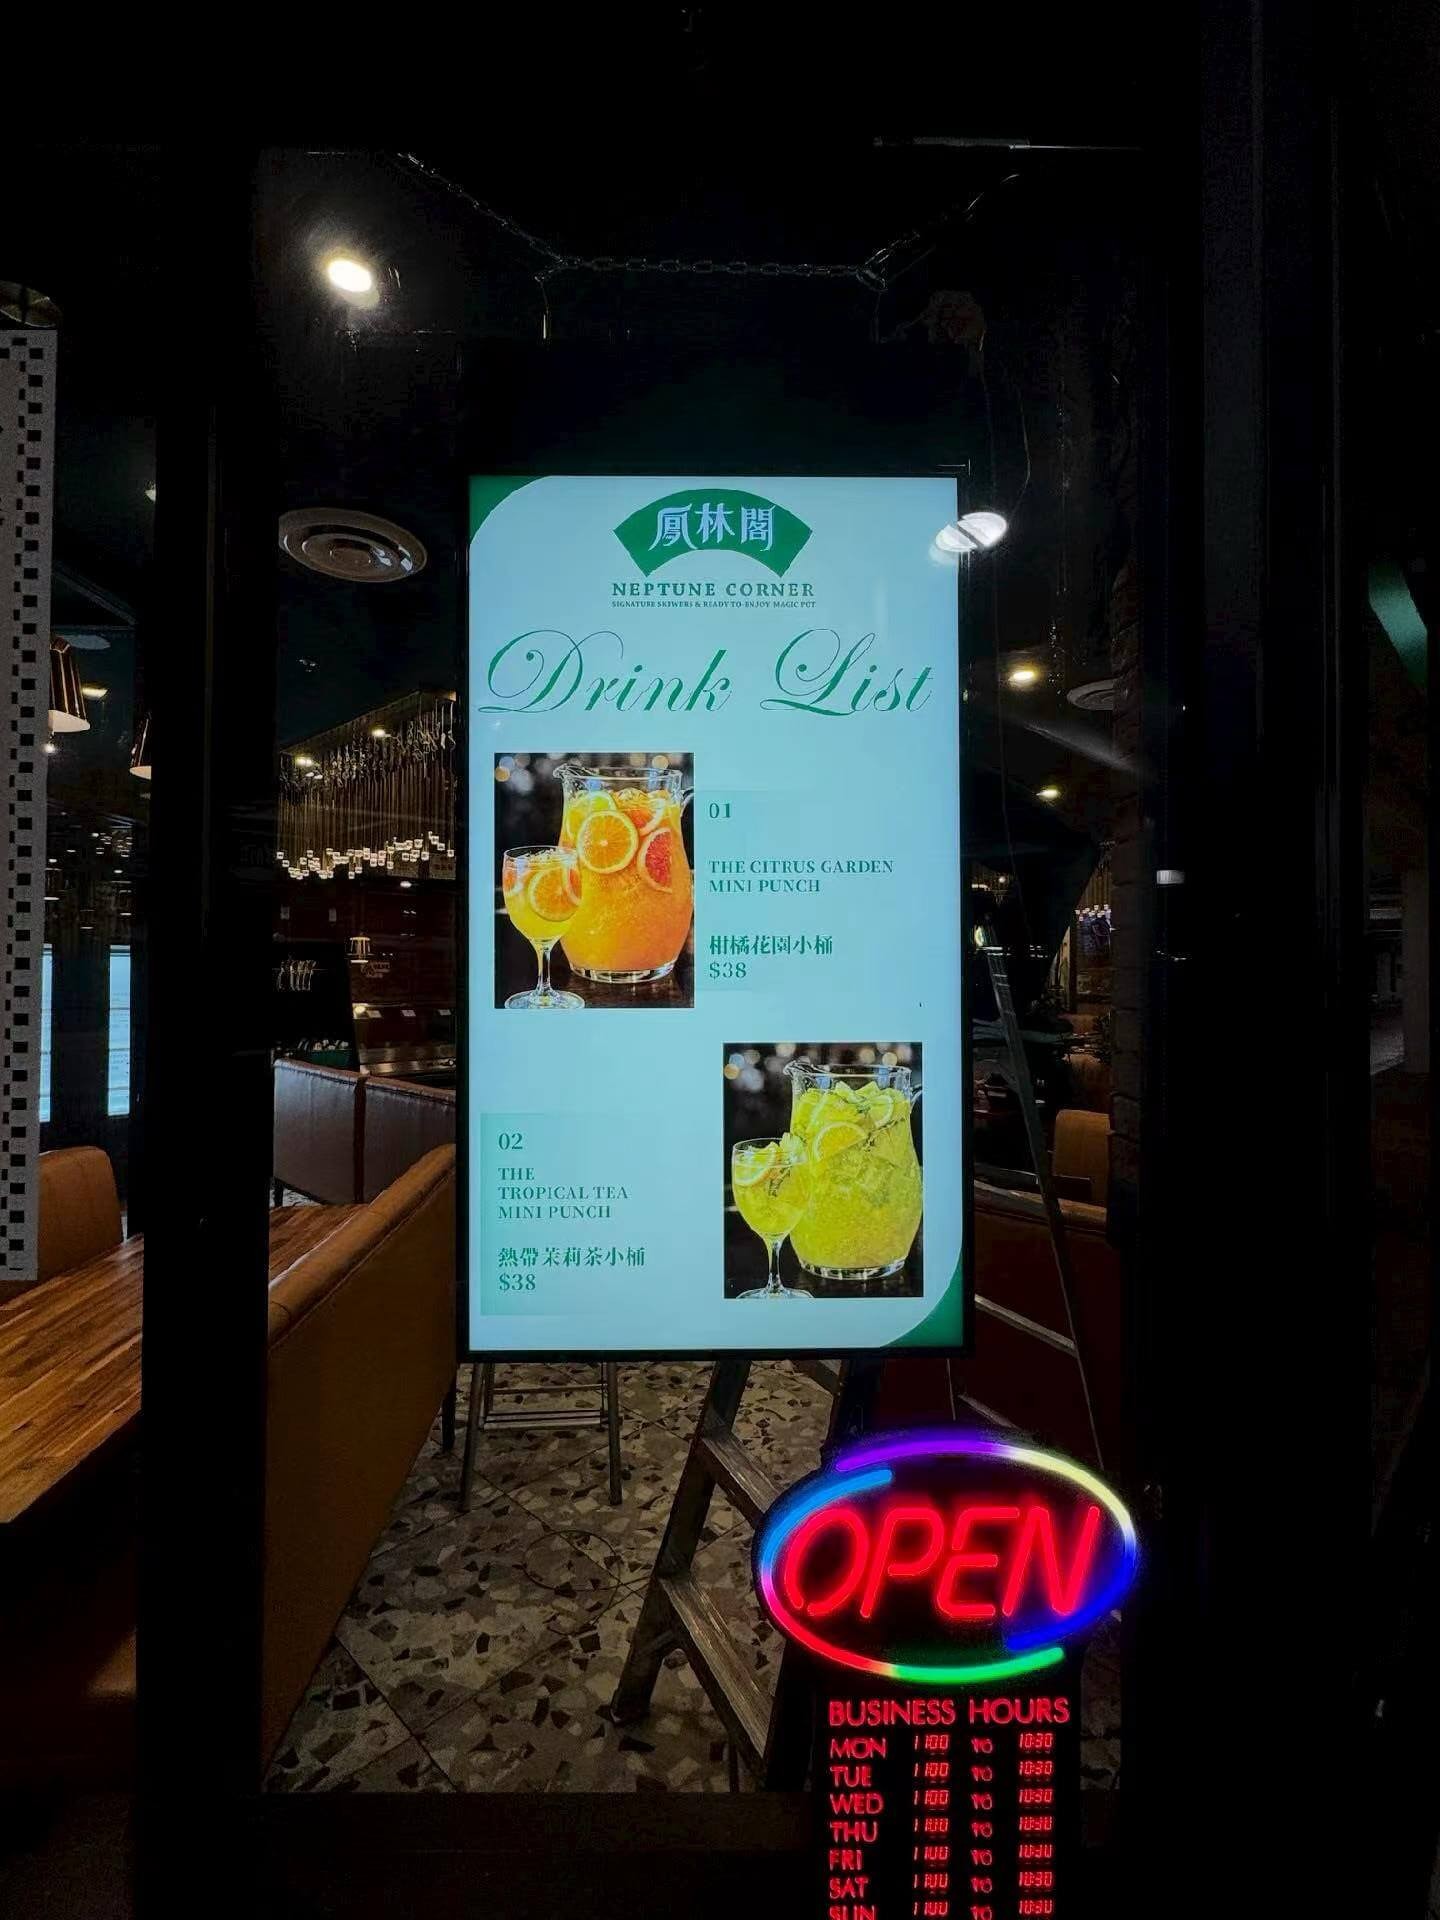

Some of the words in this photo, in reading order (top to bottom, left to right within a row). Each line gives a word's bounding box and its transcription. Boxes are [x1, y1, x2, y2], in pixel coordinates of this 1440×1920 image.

[612, 582, 716, 597] NEPTUNE
[725, 582, 815, 597] CORNER
[611, 600, 656, 608] SIGNATURE
[694, 600, 702, 608] &
[772, 600, 800, 608] MAGIC
[477, 629, 733, 714] Drink
[759, 628, 935, 717] List
[708, 802, 732, 819] 01
[708, 860, 746, 874] THE
[749, 860, 816, 874] CITRUS
[820, 860, 894, 874] GARDEN
[708, 879, 752, 893] MINI
[758, 879, 821, 893] PUNCH
[708, 935, 834, 956] 柑橘花園小桶
[708, 962, 748, 980] $38
[498, 1132, 524, 1150] 02
[497, 1167, 536, 1181] THE
[497, 1186, 590, 1200] TROPICAL
[592, 1186, 630, 1200] TEA
[497, 1205, 542, 1219] MINI
[548, 1205, 612, 1219] PUNCH
[497, 1247, 646, 1268] 熱帶茉莉茶小桶
[498, 1273, 537, 1292] $38
[783, 1505, 1101, 1619] OPEN
[828, 1699, 957, 1726] BUSINESS
[968, 1698, 1071, 1724] HOURS
[830, 1738, 888, 1759] MON
[829, 1766, 873, 1787] TUE
[830, 1793, 885, 1815] WED
[829, 1821, 880, 1843] THU
[828, 1849, 864, 1871] FRI
[828, 1876, 870, 1899] SAT
[828, 1904, 877, 1920] SUN
